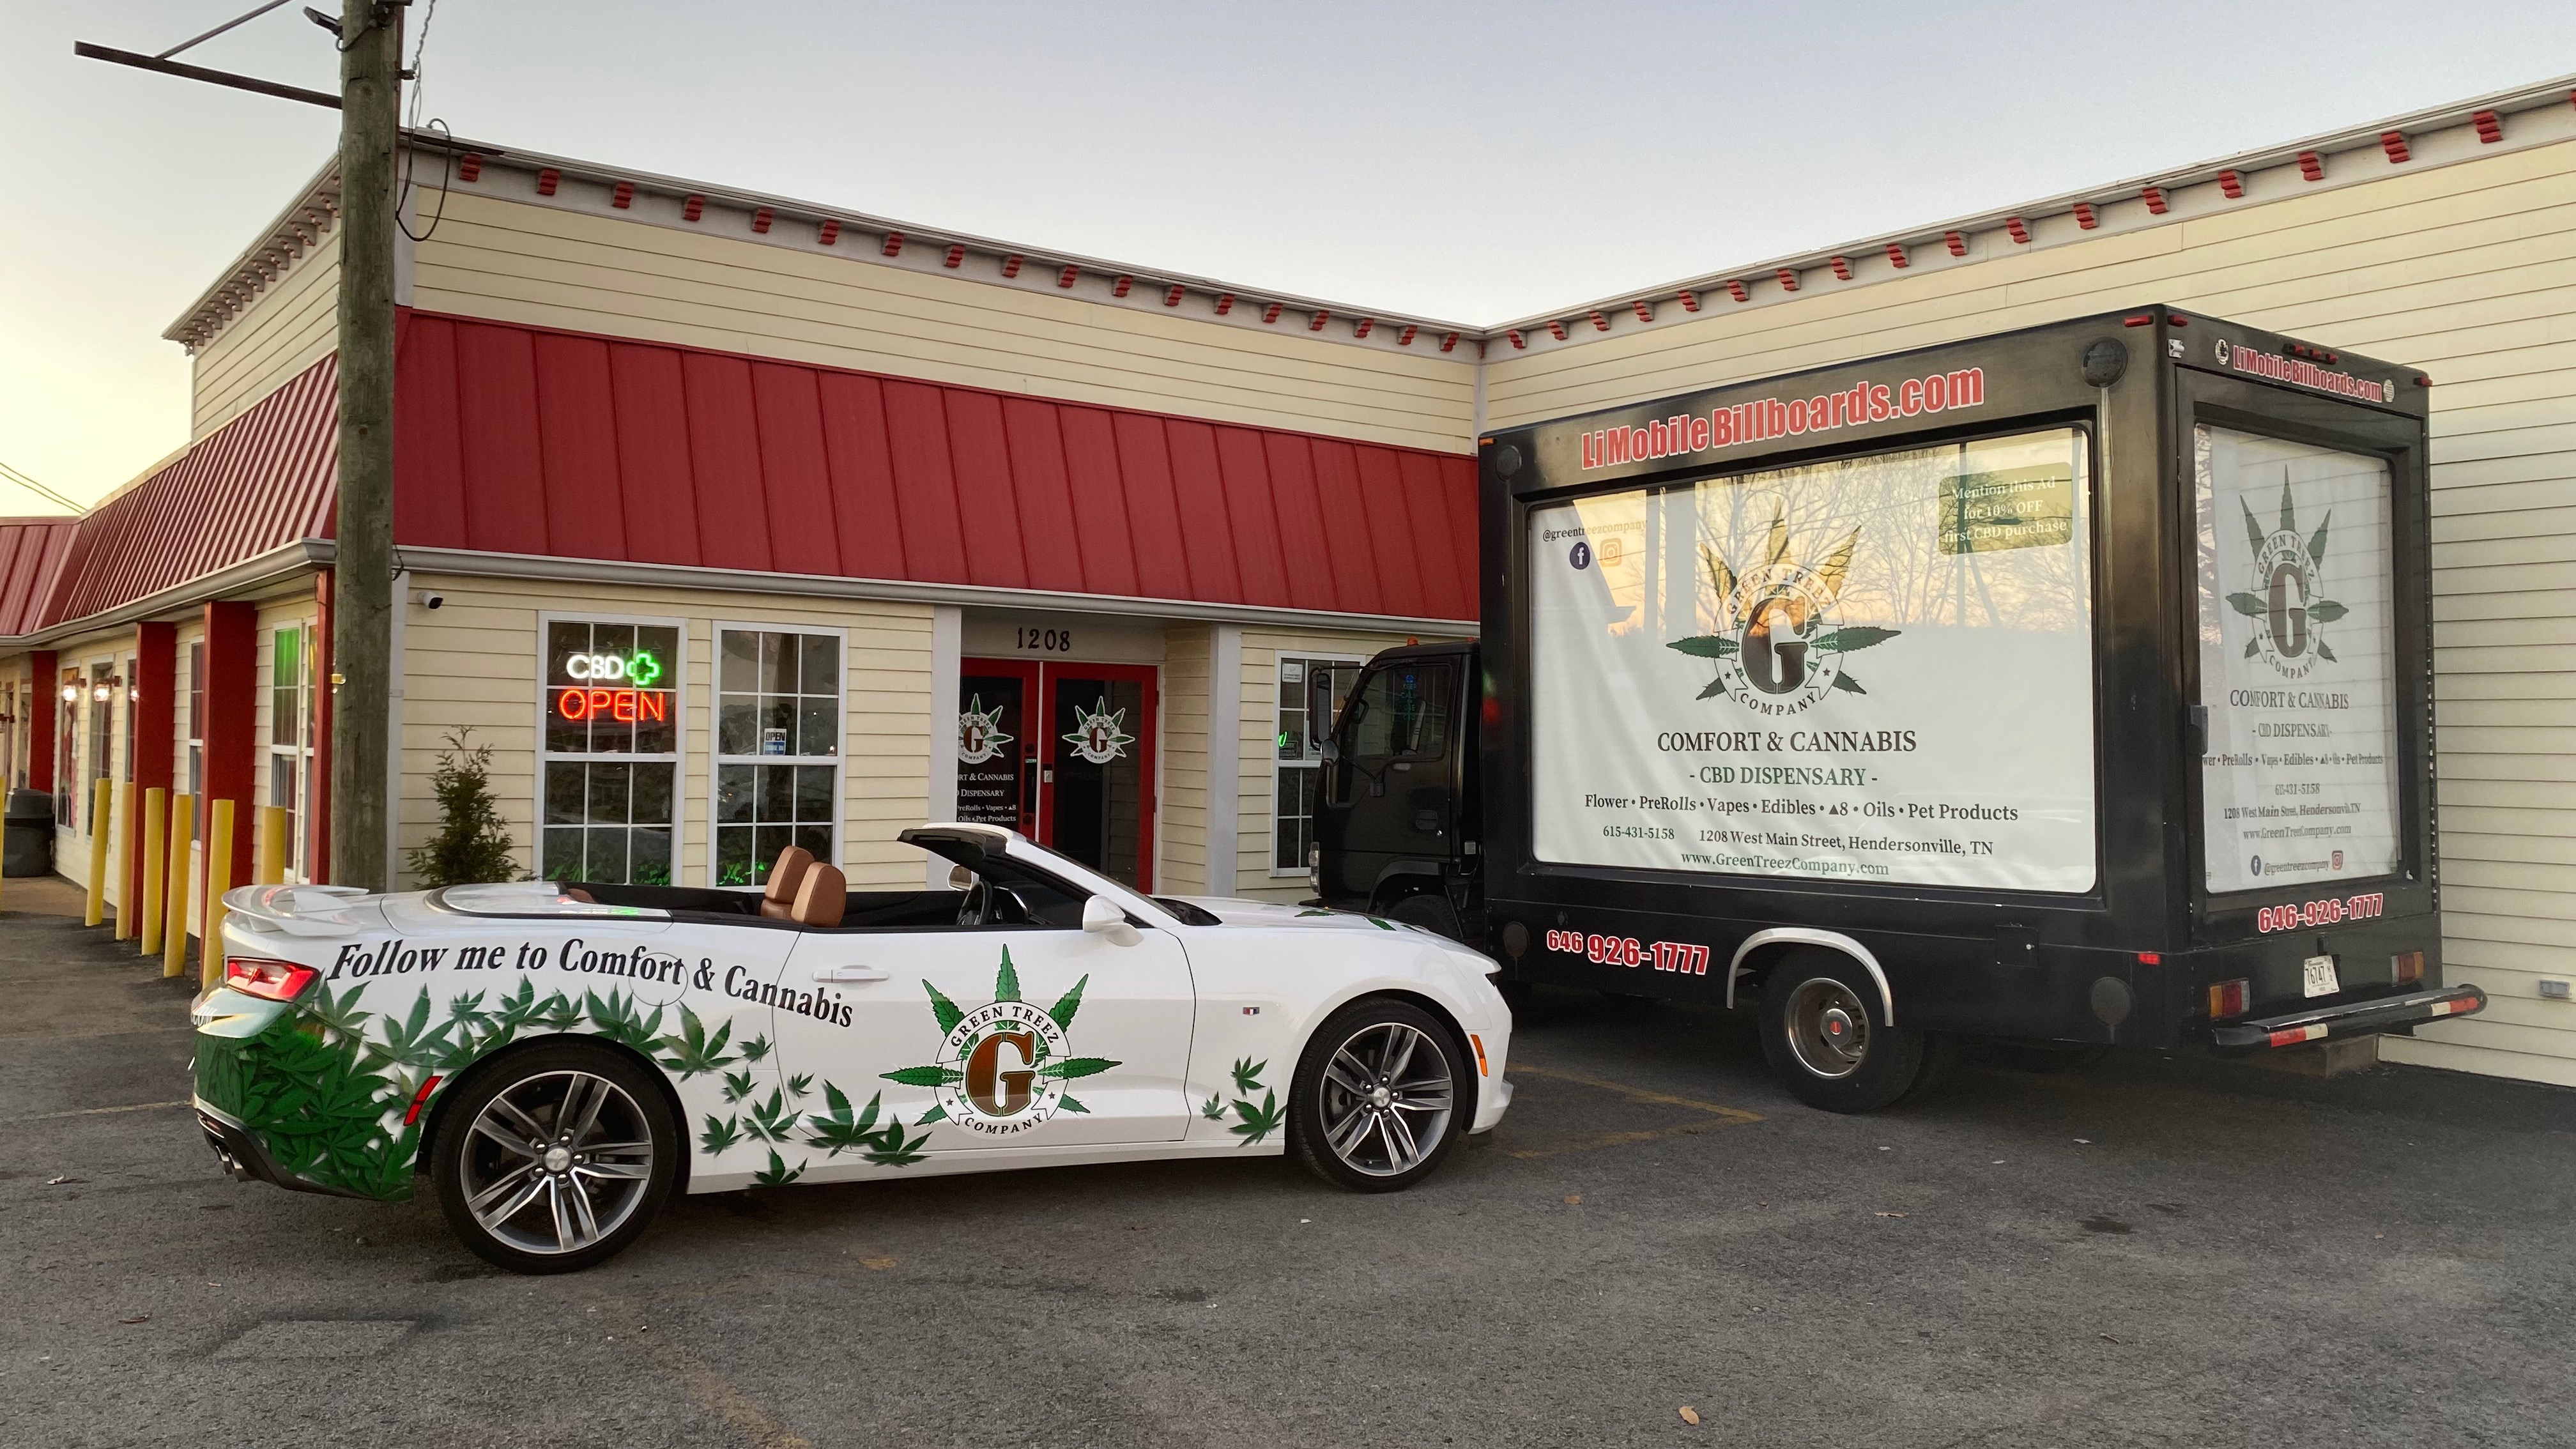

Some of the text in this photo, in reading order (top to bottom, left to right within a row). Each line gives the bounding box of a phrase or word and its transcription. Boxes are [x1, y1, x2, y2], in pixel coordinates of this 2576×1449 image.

[1952, 476, 2055, 500] Mention this Ad
[1964, 500, 2043, 519] for 10% OFF
[1945, 521, 2067, 543] first CBD purchase
[1726, 569, 1772, 614] GREEN
[1782, 568, 1831, 608] TREEZ
[1018, 627, 1070, 652] 1208
[566, 654, 624, 679] CBD
[2269, 655, 2315, 678] COMPANY
[559, 689, 665, 721] OPEN
[1740, 692, 1817, 716] COMPANY
[2288, 691, 2296, 708] &
[766, 732, 785, 740] OPEN
[1657, 731, 1917, 751] COMFORT & CANNABIS
[2222, 753, 2253, 765] PreRolls
[2284, 753, 2313, 765] Edibles
[969, 772, 976, 781] &
[977, 772, 1014, 781] CANNABIS
[1699, 767, 1866, 786] CBD DISPENSARY
[1585, 794, 1628, 809] Flower
[1640, 796, 1696, 811] PreRolls
[1706, 798, 1749, 816] Vapes
[1761, 799, 1816, 815] Edibles
[1864, 801, 1894, 818] Oils
[1908, 803, 1935, 819] Pet
[1939, 804, 2018, 820] Products
[2224, 807, 2240, 819] 1208
[2241, 807, 2258, 818] West
[2258, 804, 2280, 817] Main
[1603, 825, 1993, 857] 615-431-5158 1208 West Main Street, Hendersonville, TN
[1681, 853, 1889, 877] www.GreenTreezCompany.com
[2258, 893, 2383, 933] 646-926-1777
[1547, 930, 1710, 976] 646 926-1777
[326, 938, 853, 1028] Follow me to Comfort & Cannabis
[951, 1006, 1059, 1048] GREEN TREEZ
[965, 1031, 1036, 1117] G
[965, 1112, 1043, 1135] COMPANY
